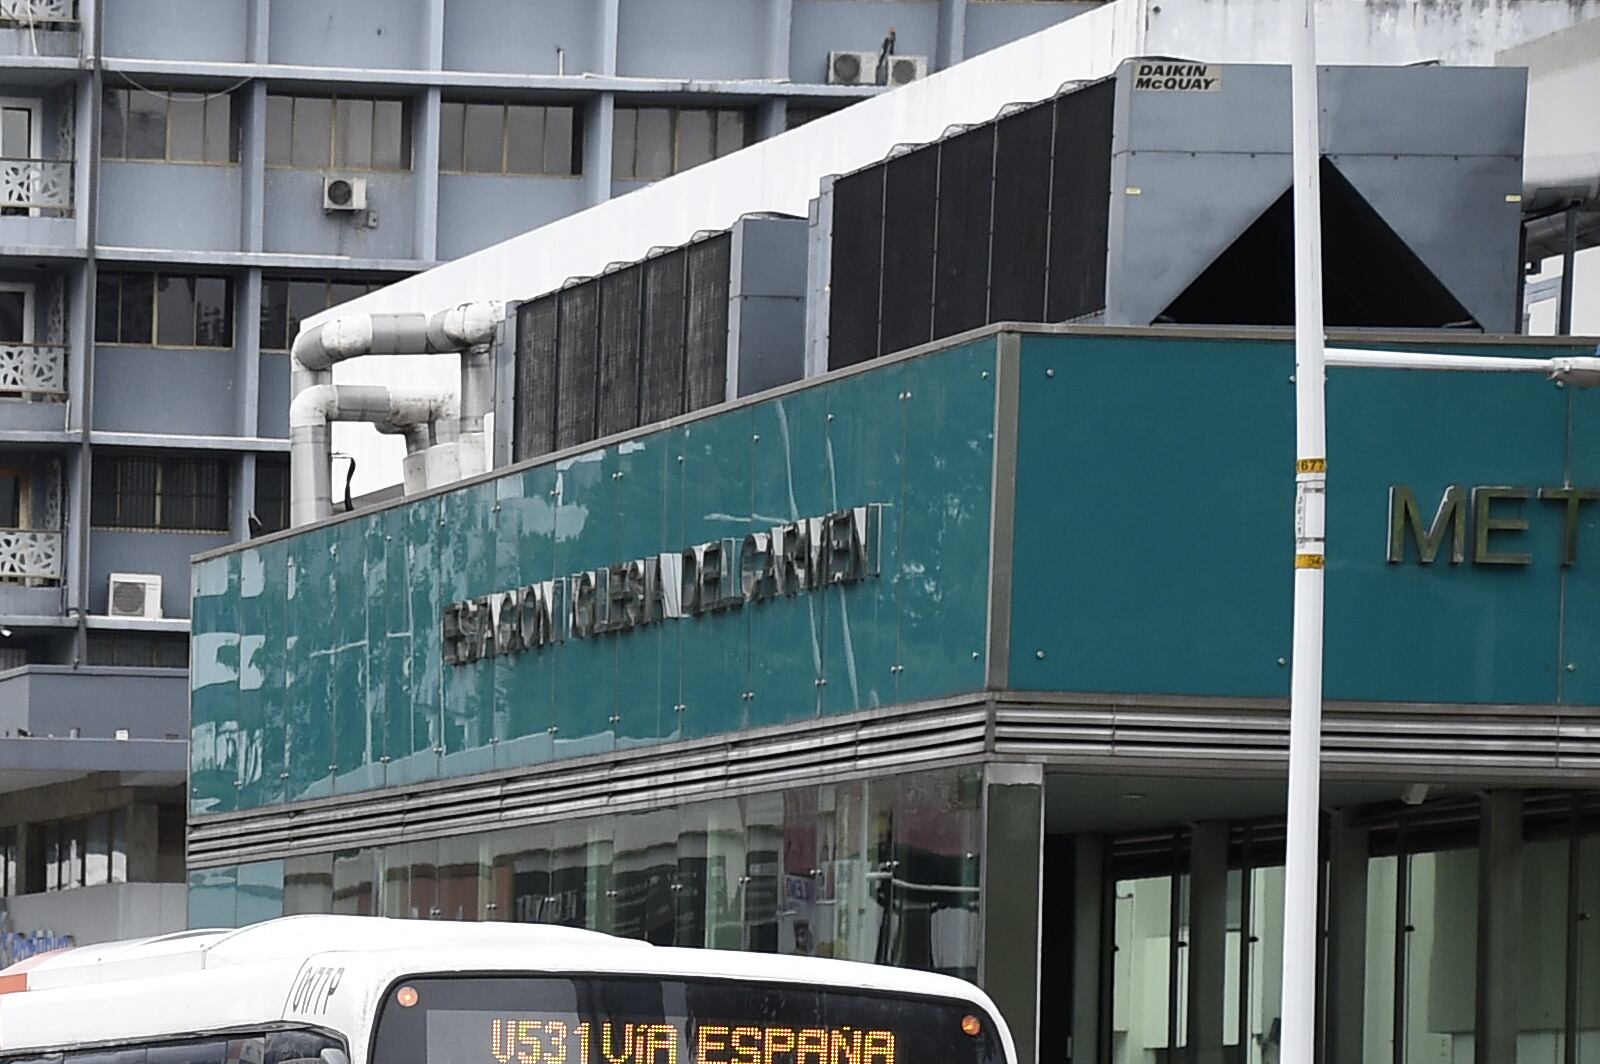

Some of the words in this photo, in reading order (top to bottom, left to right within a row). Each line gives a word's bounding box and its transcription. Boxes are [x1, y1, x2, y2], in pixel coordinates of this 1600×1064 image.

[1135, 77, 1216, 90] McQUAY
[1138, 65, 1208, 77] DAIKIN
[1386, 484, 1600, 566] MET
[441, 576, 566, 667] ESTACION
[568, 553, 683, 639] IGLESIA
[681, 540, 744, 615] DEL
[740, 504, 882, 604] CARMEN
